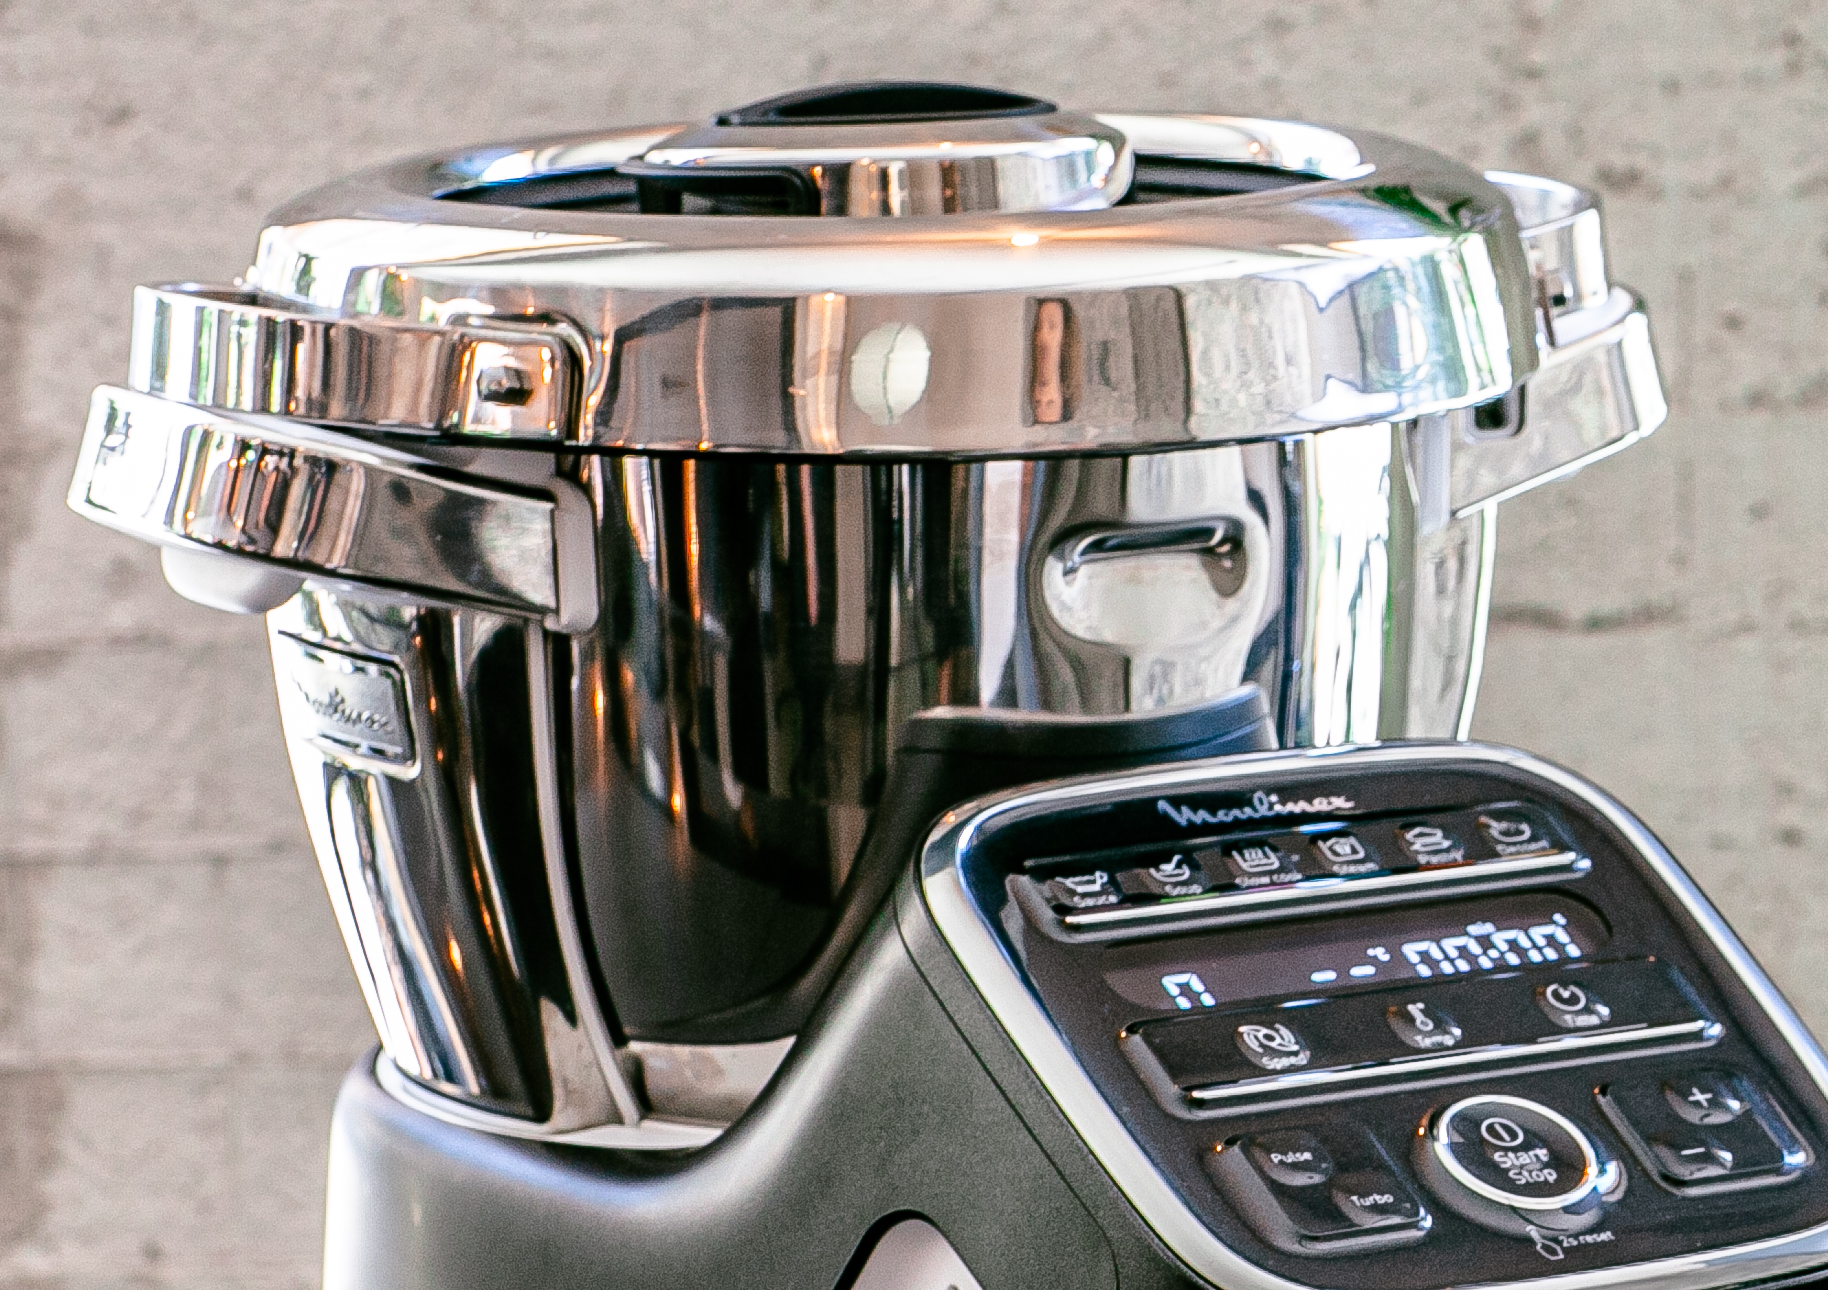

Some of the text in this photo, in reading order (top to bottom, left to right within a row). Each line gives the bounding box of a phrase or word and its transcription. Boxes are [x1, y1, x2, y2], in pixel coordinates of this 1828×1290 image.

[1157, 790, 1355, 826] Moulinex
[1332, 861, 1379, 875] Steam
[1164, 883, 1203, 897] Soup
[1072, 893, 1118, 908] Sauce
[1262, 1050, 1310, 1071] Speed
[1413, 1034, 1456, 1049] Temp
[1270, 1151, 1314, 1165] Pulse
[1493, 1147, 1550, 1169] Start
[1508, 1168, 1558, 1186] Stop
[1350, 1193, 1395, 1207] Turbo
[1579, 1230, 1616, 1245] reset
